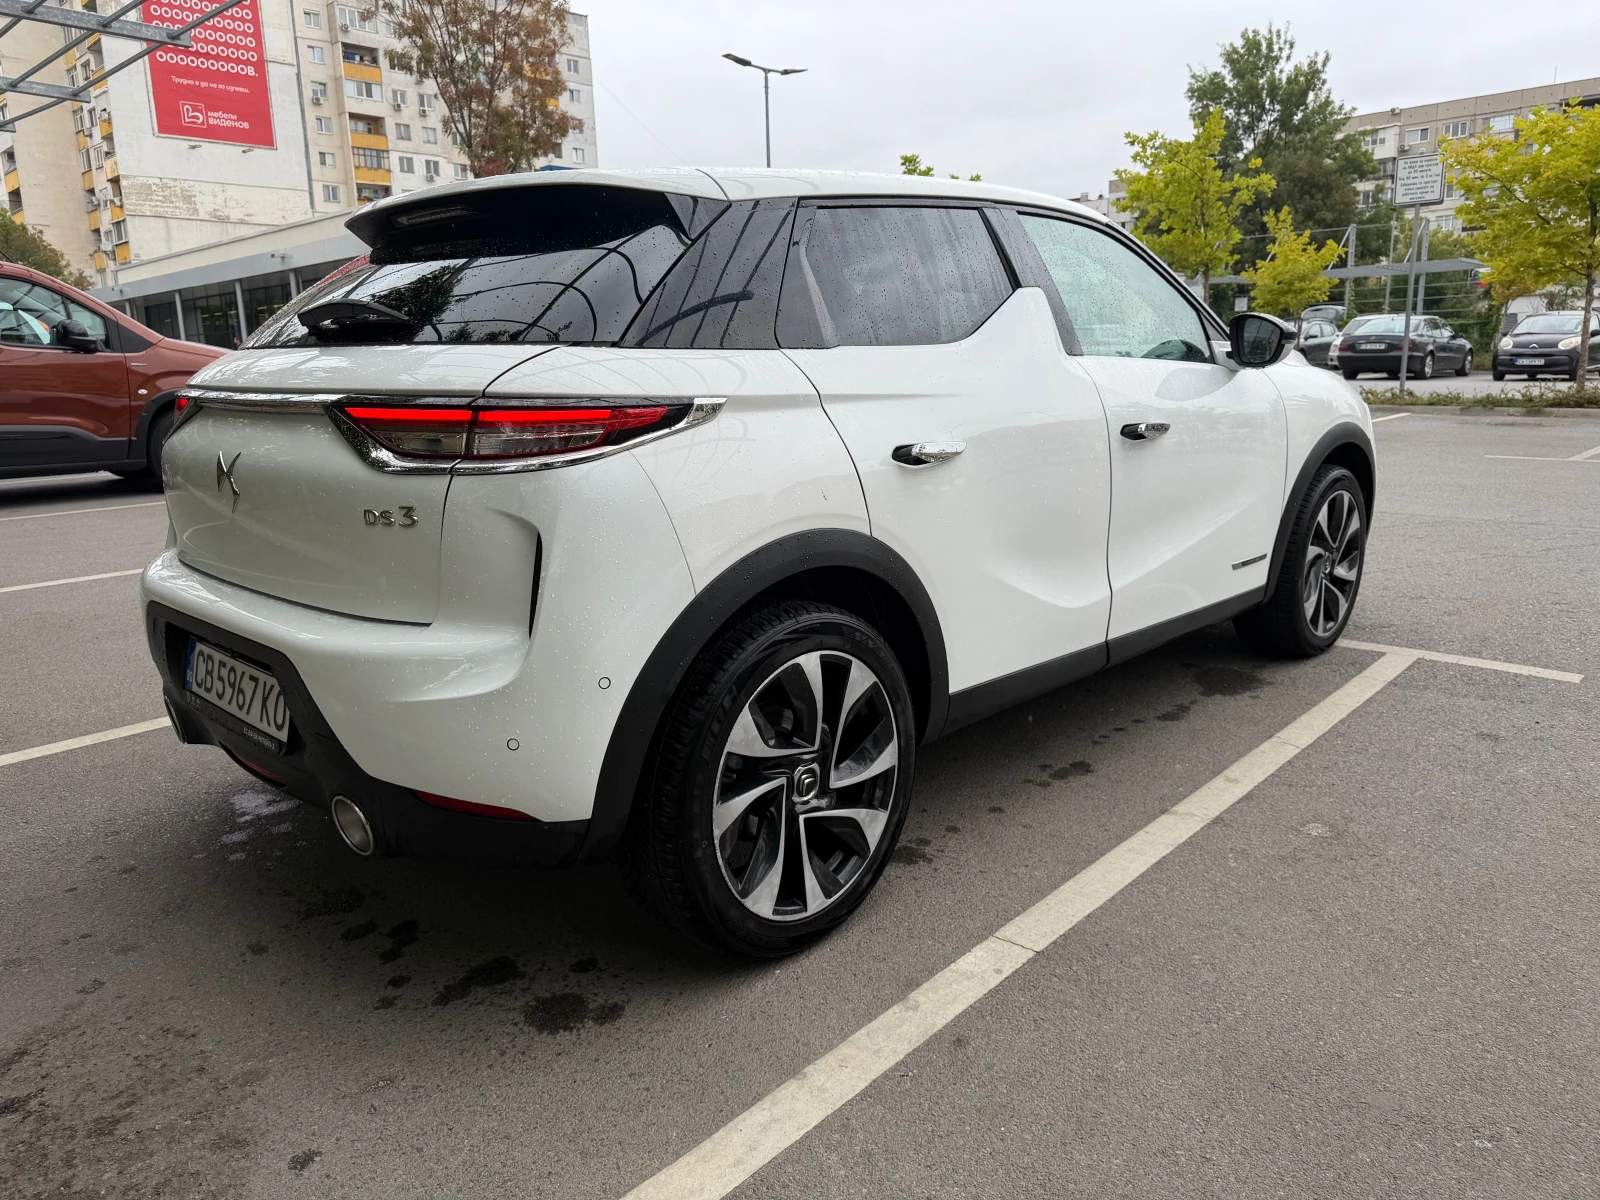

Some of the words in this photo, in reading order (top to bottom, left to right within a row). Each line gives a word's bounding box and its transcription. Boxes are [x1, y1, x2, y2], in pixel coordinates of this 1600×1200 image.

[171, 75, 194, 85] Трудно
[208, 110, 237, 120] мебели
[364, 509, 396, 527] DS
[398, 505, 419, 528] 3
